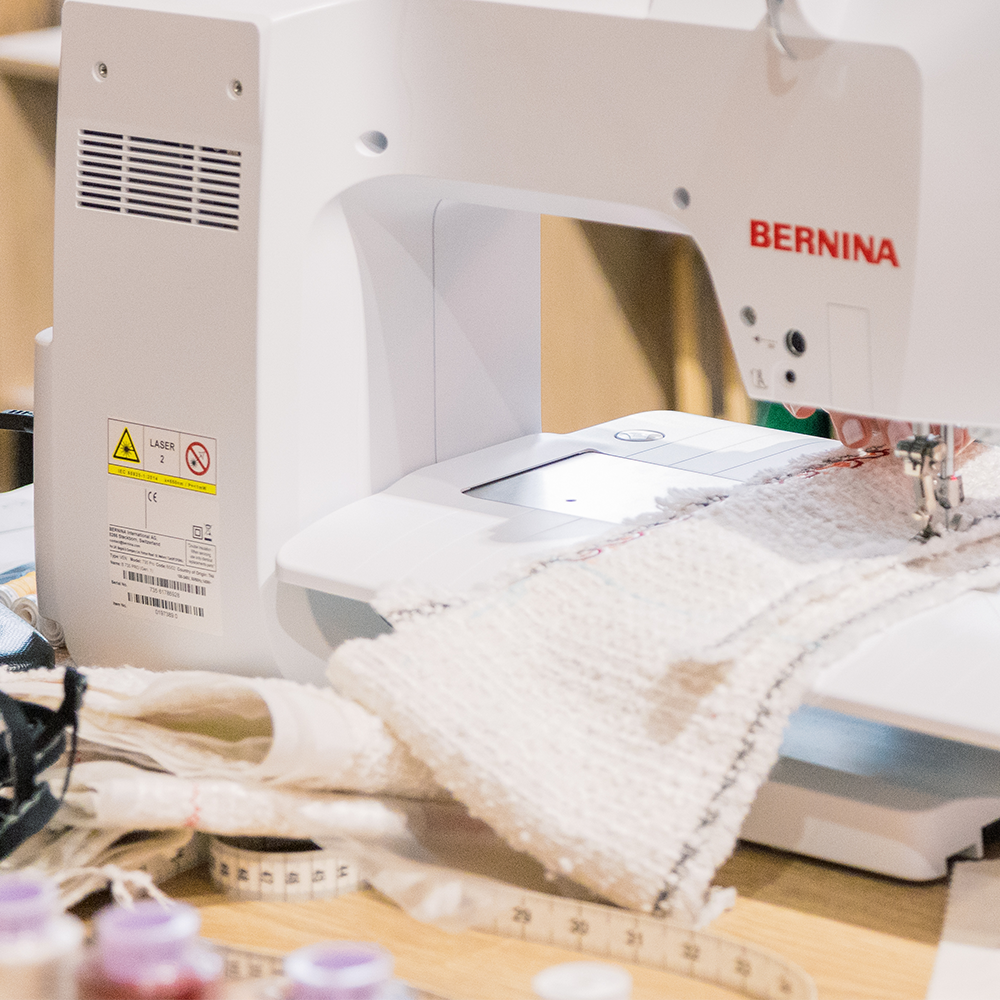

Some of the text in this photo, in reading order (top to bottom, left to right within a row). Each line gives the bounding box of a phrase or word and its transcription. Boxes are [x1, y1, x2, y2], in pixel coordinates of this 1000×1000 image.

[750, 219, 900, 268] BERNINA
[150, 439, 175, 451] LASER
[160, 455, 165, 464] 2
[109, 526, 126, 534] BERNINA
[127, 530, 150, 539] International
[512, 905, 532, 924] 29
